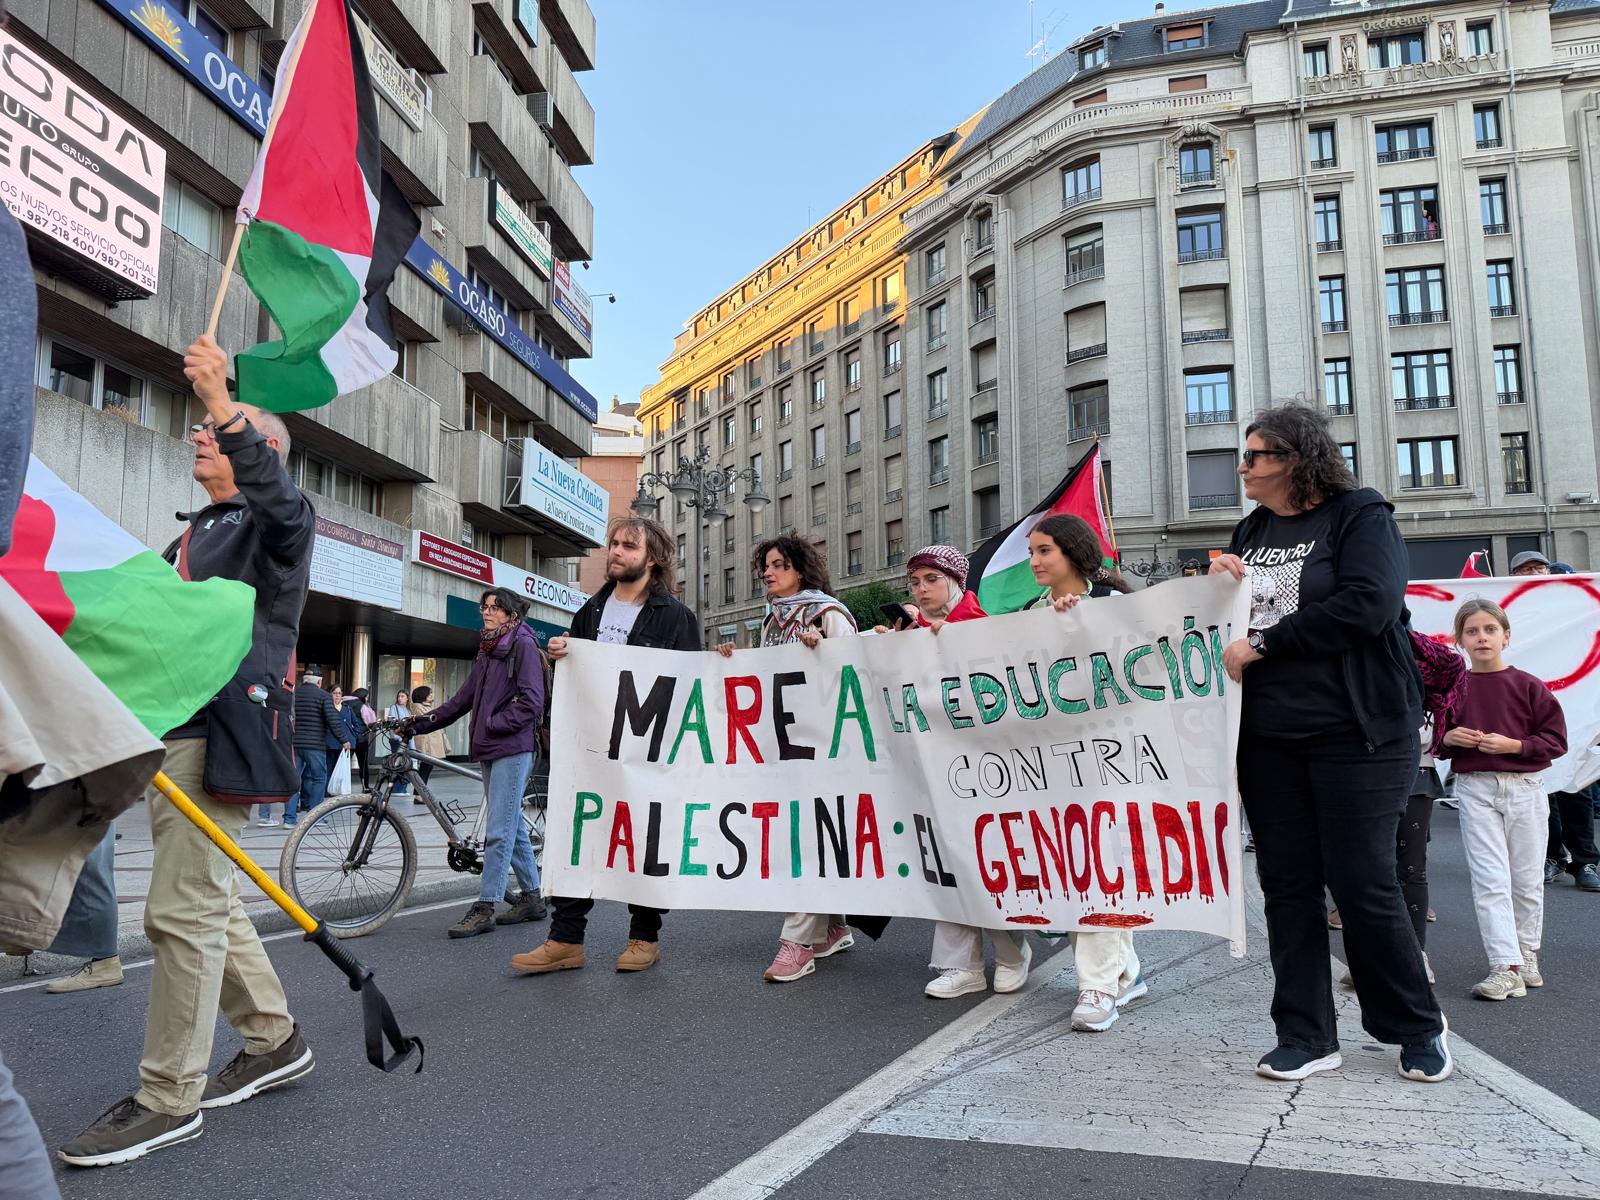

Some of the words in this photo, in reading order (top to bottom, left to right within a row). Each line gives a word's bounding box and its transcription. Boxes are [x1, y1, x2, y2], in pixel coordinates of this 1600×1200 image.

[2, 43, 152, 177] ODA
[1305, 70, 1372, 95] HOTEL
[0, 94, 58, 142] UTO
[61, 143, 100, 173] GRUPO
[0, 180, 17, 197] OS
[21, 191, 68, 226] NUEVOS
[70, 220, 118, 255] SERVICIO
[119, 249, 156, 278] OFICIAL
[51, 223, 70, 241] 218
[122, 263, 139, 280] 201
[141, 274, 156, 290] 351
[458, 281, 505, 337] OCASO
[509, 331, 541, 369] SEGUROS
[538, 452, 549, 477] La
[551, 460, 575, 495] Nueva
[577, 478, 603, 513] Crónica
[327, 524, 357, 542] COMERCIAL
[883, 683, 931, 733] LA
[948, 734, 1168, 799] CONTRA
[913, 813, 958, 888] EL
